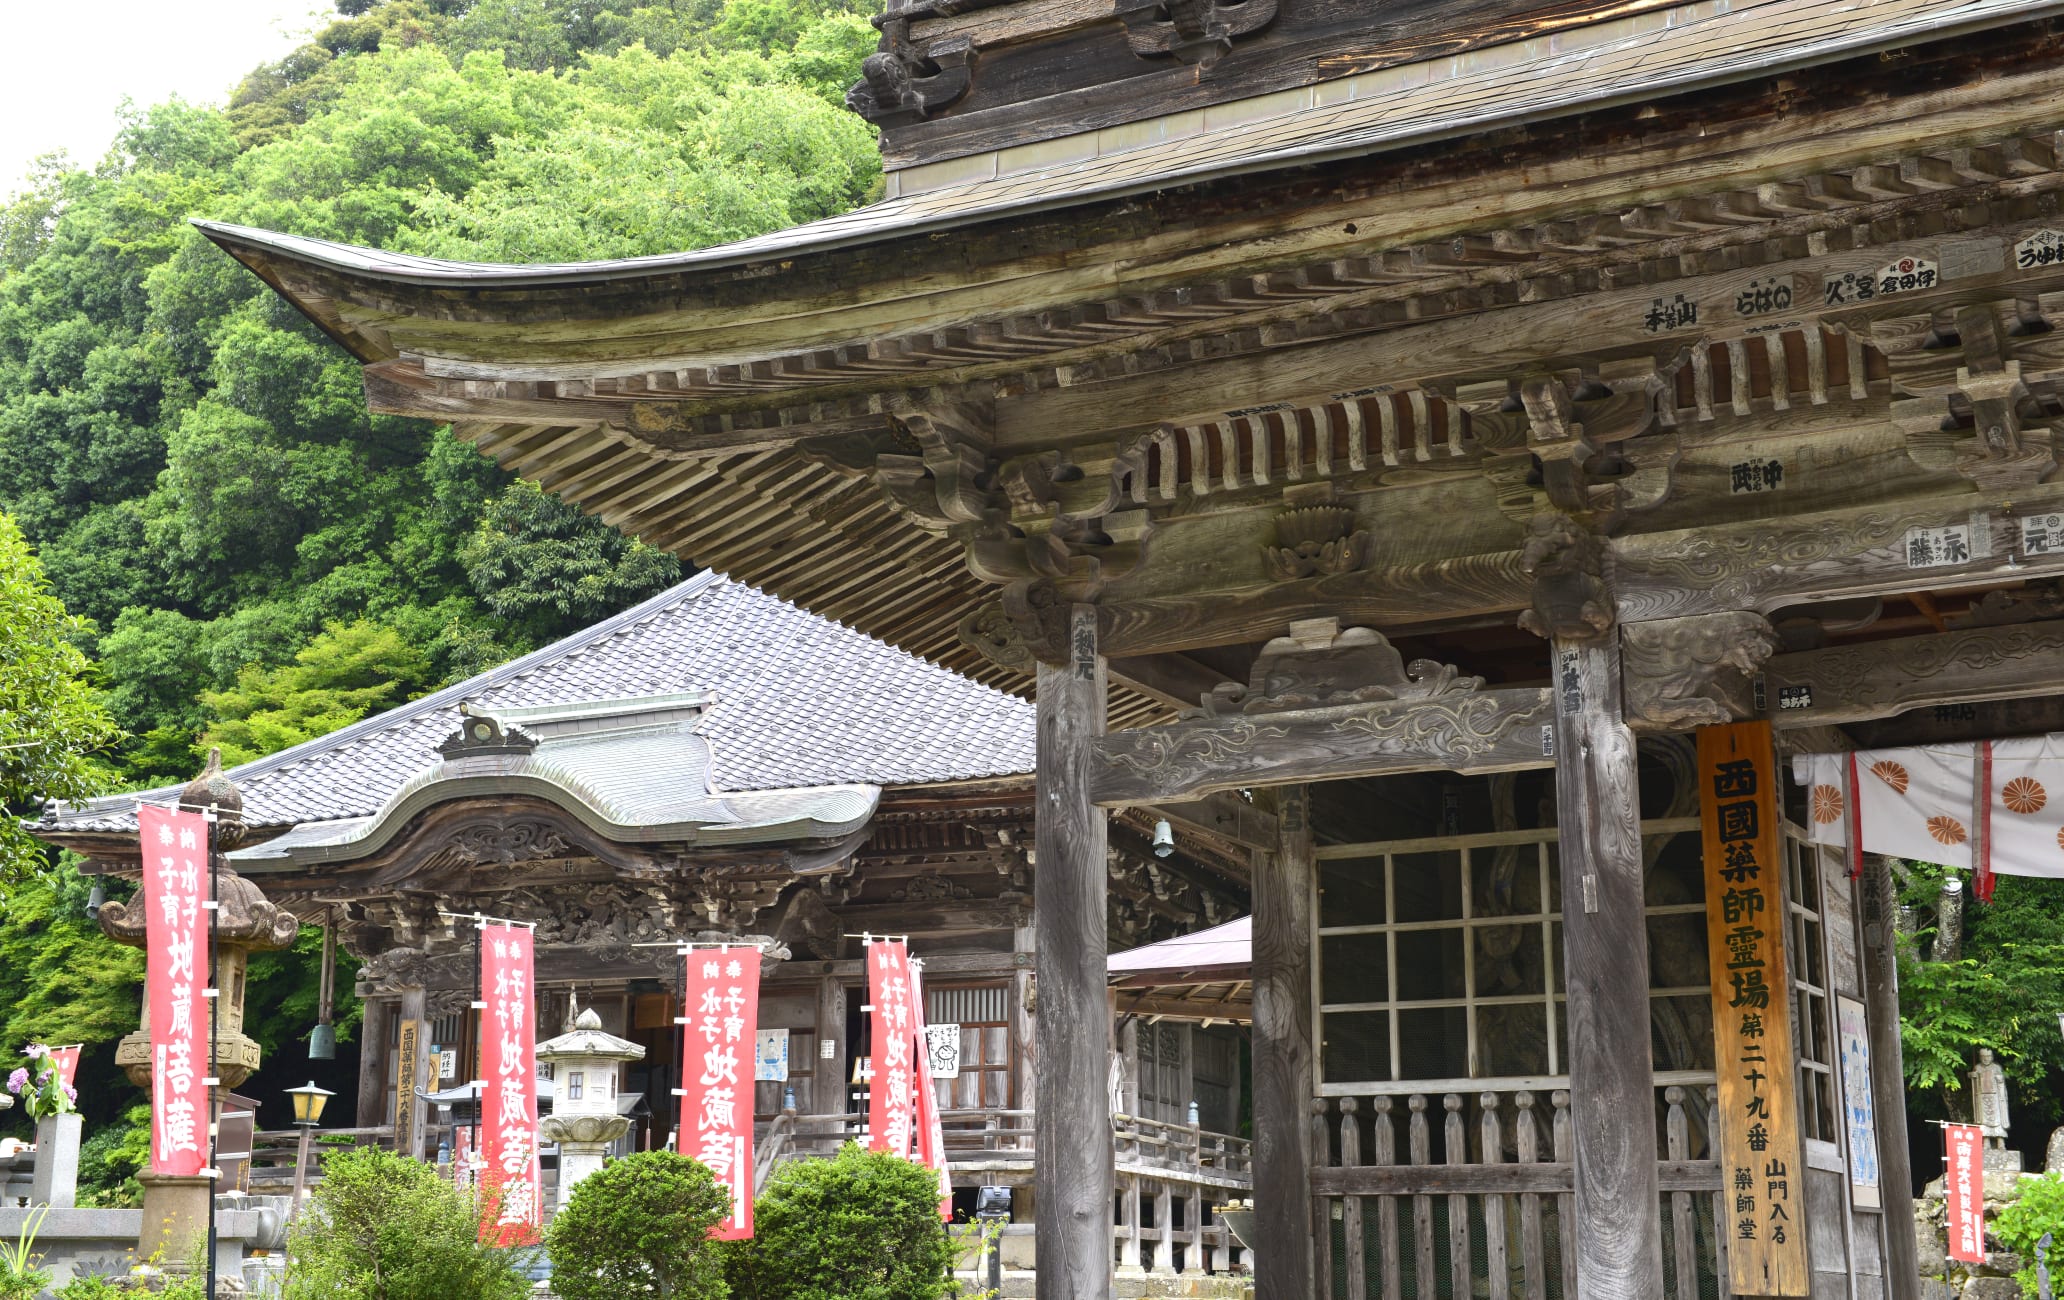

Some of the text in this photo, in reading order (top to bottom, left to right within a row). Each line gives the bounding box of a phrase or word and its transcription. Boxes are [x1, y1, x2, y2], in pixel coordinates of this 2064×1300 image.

[159, 823, 197, 851] 奉納
[165, 931, 198, 1155] 地蔵菩薩
